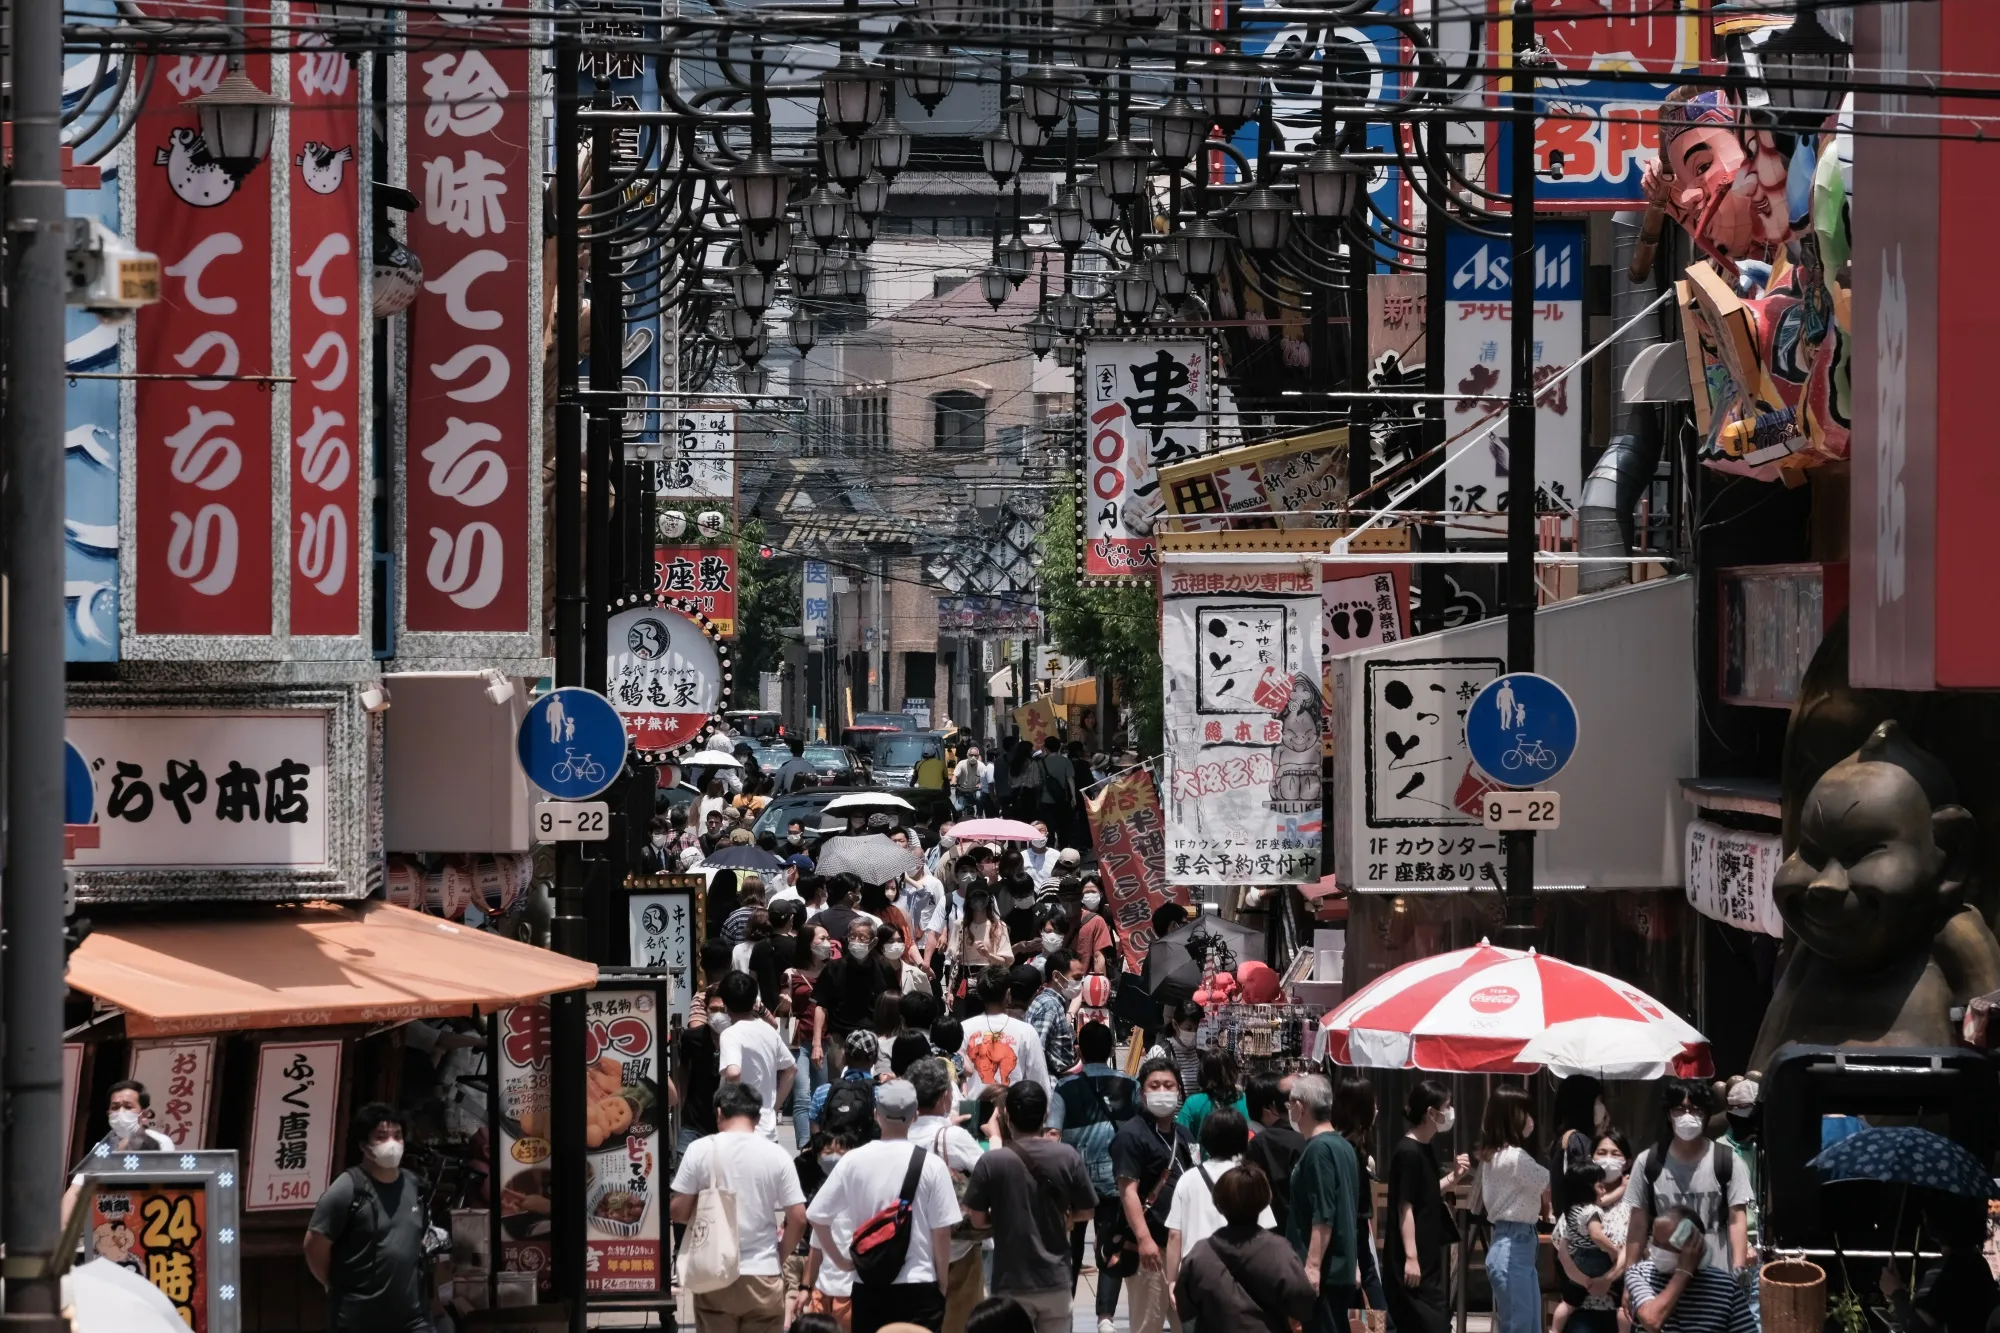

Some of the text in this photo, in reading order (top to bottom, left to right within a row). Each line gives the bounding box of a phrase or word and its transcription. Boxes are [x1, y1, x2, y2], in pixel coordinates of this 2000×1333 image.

[1452, 243, 1571, 290] Ashi
[1458, 303, 1563, 322] アサヒール
[1097, 366, 1114, 398] 全て
[1186, 353, 1201, 396] 新世界
[1263, 452, 1320, 493] 新世界
[806, 561, 827, 620] 医院
[1171, 572, 1314, 593] 元祖串カツ専門店
[1255, 620, 1275, 664] 新世界
[1044, 649, 1062, 676] 一平
[618, 676, 700, 707] 鶴亀家
[620, 715, 679, 732] 年中無休
[1204, 720, 1283, 743] 総本店
[92, 757, 311, 825] らや本店
[1173, 753, 1276, 802] 大阪名物
[540, 811, 603, 832] 9-22
[1489, 801, 1554, 821] 9-22
[1172, 853, 1316, 876] 宴会予約受付中
[674, 949, 686, 989] ど焼
[165, 1054, 197, 1146] おみやげ
[274, 1053, 316, 1171] ふぐ唐揚
[267, 1181, 311, 1202] 1,540
[140, 1197, 202, 1333] 24時
